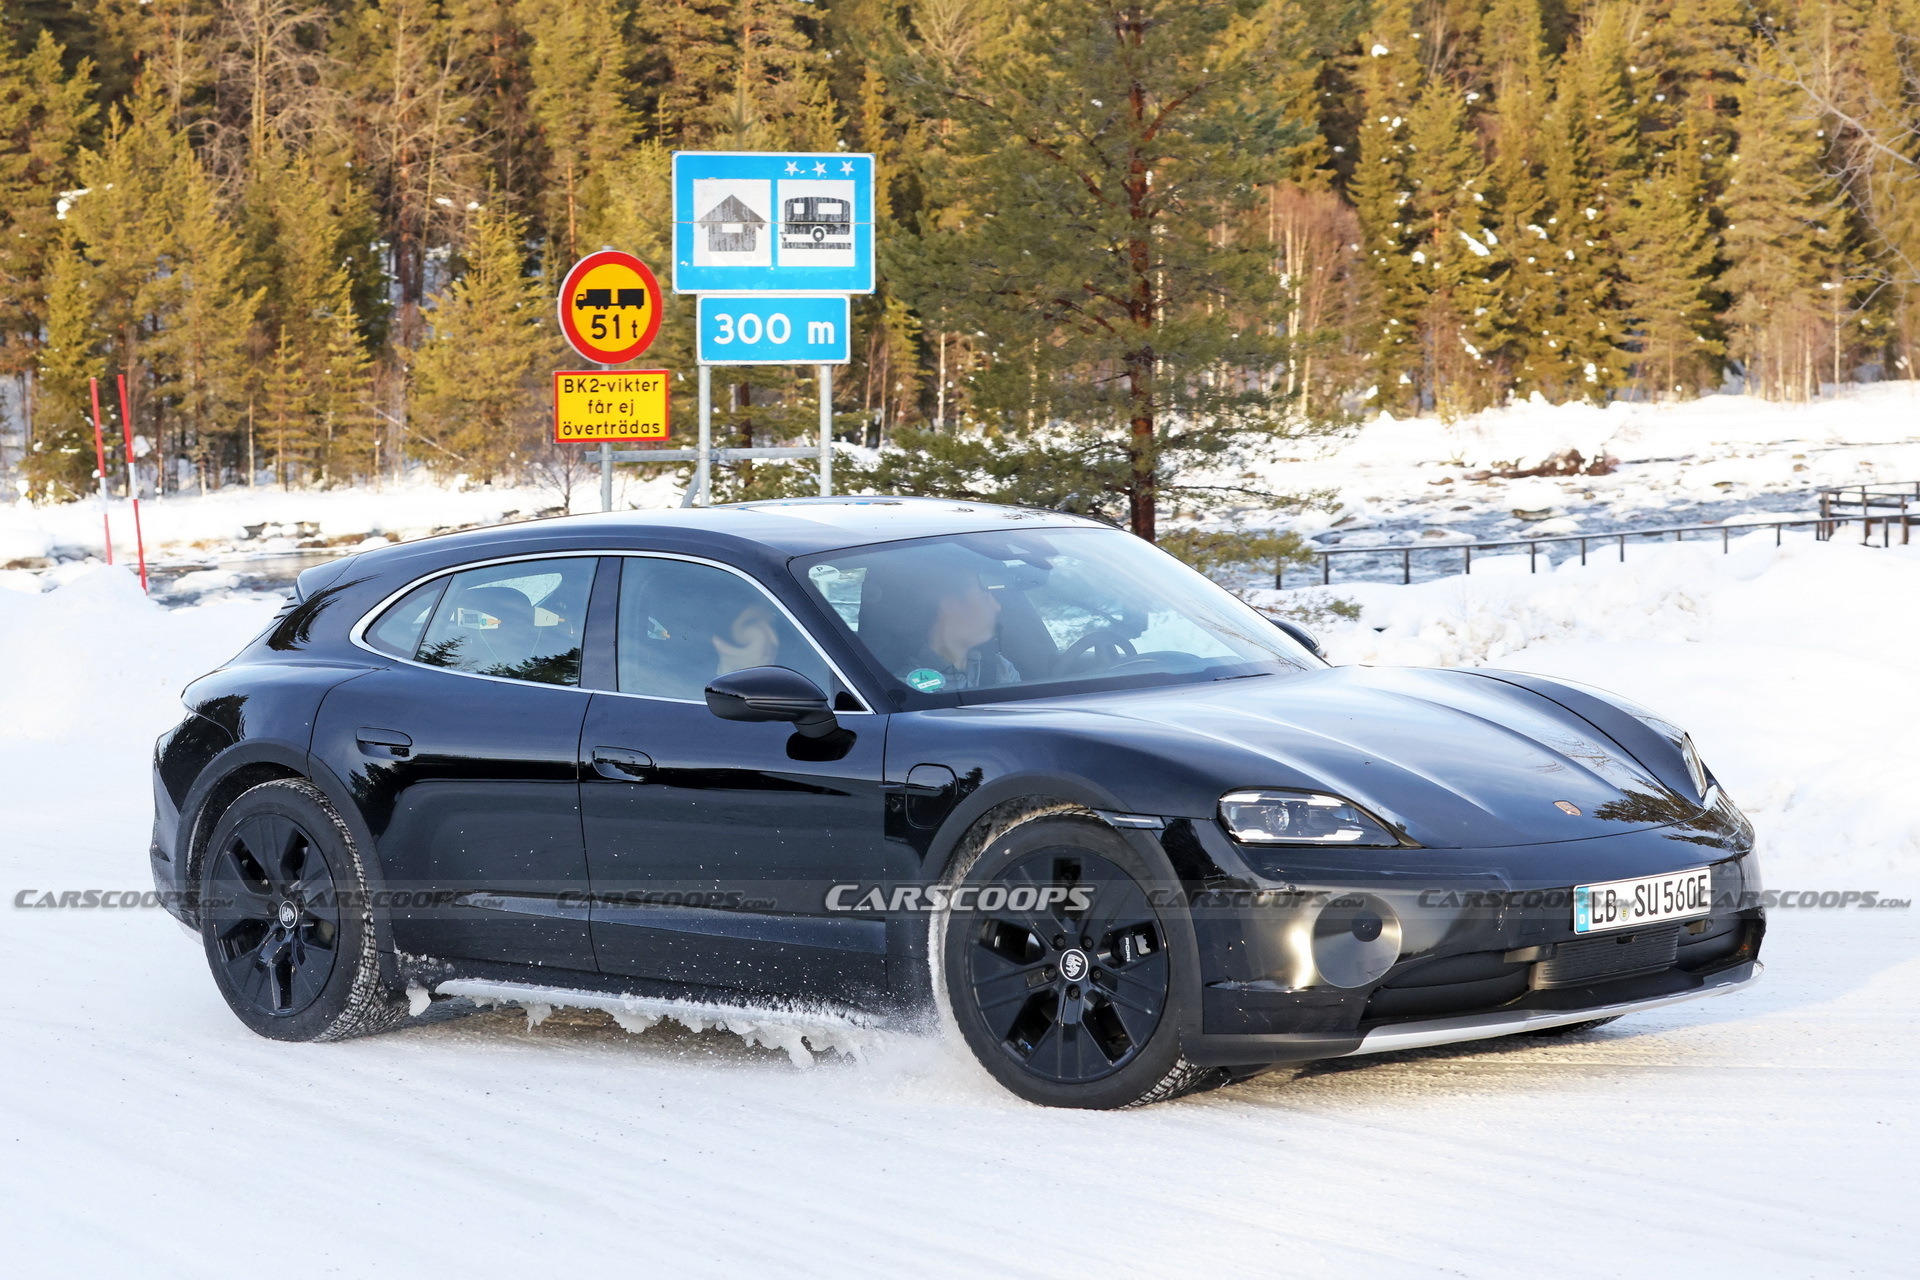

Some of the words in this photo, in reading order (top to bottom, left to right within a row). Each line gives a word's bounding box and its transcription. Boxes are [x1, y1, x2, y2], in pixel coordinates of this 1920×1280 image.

[591, 314, 620, 340] 51
[631, 320, 638, 339] t
[713, 312, 792, 345] 300
[807, 320, 835, 345] m
[564, 378, 659, 393] BK2-vikter
[588, 399, 613, 414] får
[619, 399, 634, 417] ej
[563, 420, 660, 436] överträdas
[1592, 889, 1617, 924] LB
[1634, 882, 1659, 917] SU
[1664, 874, 1708, 914] 560E
